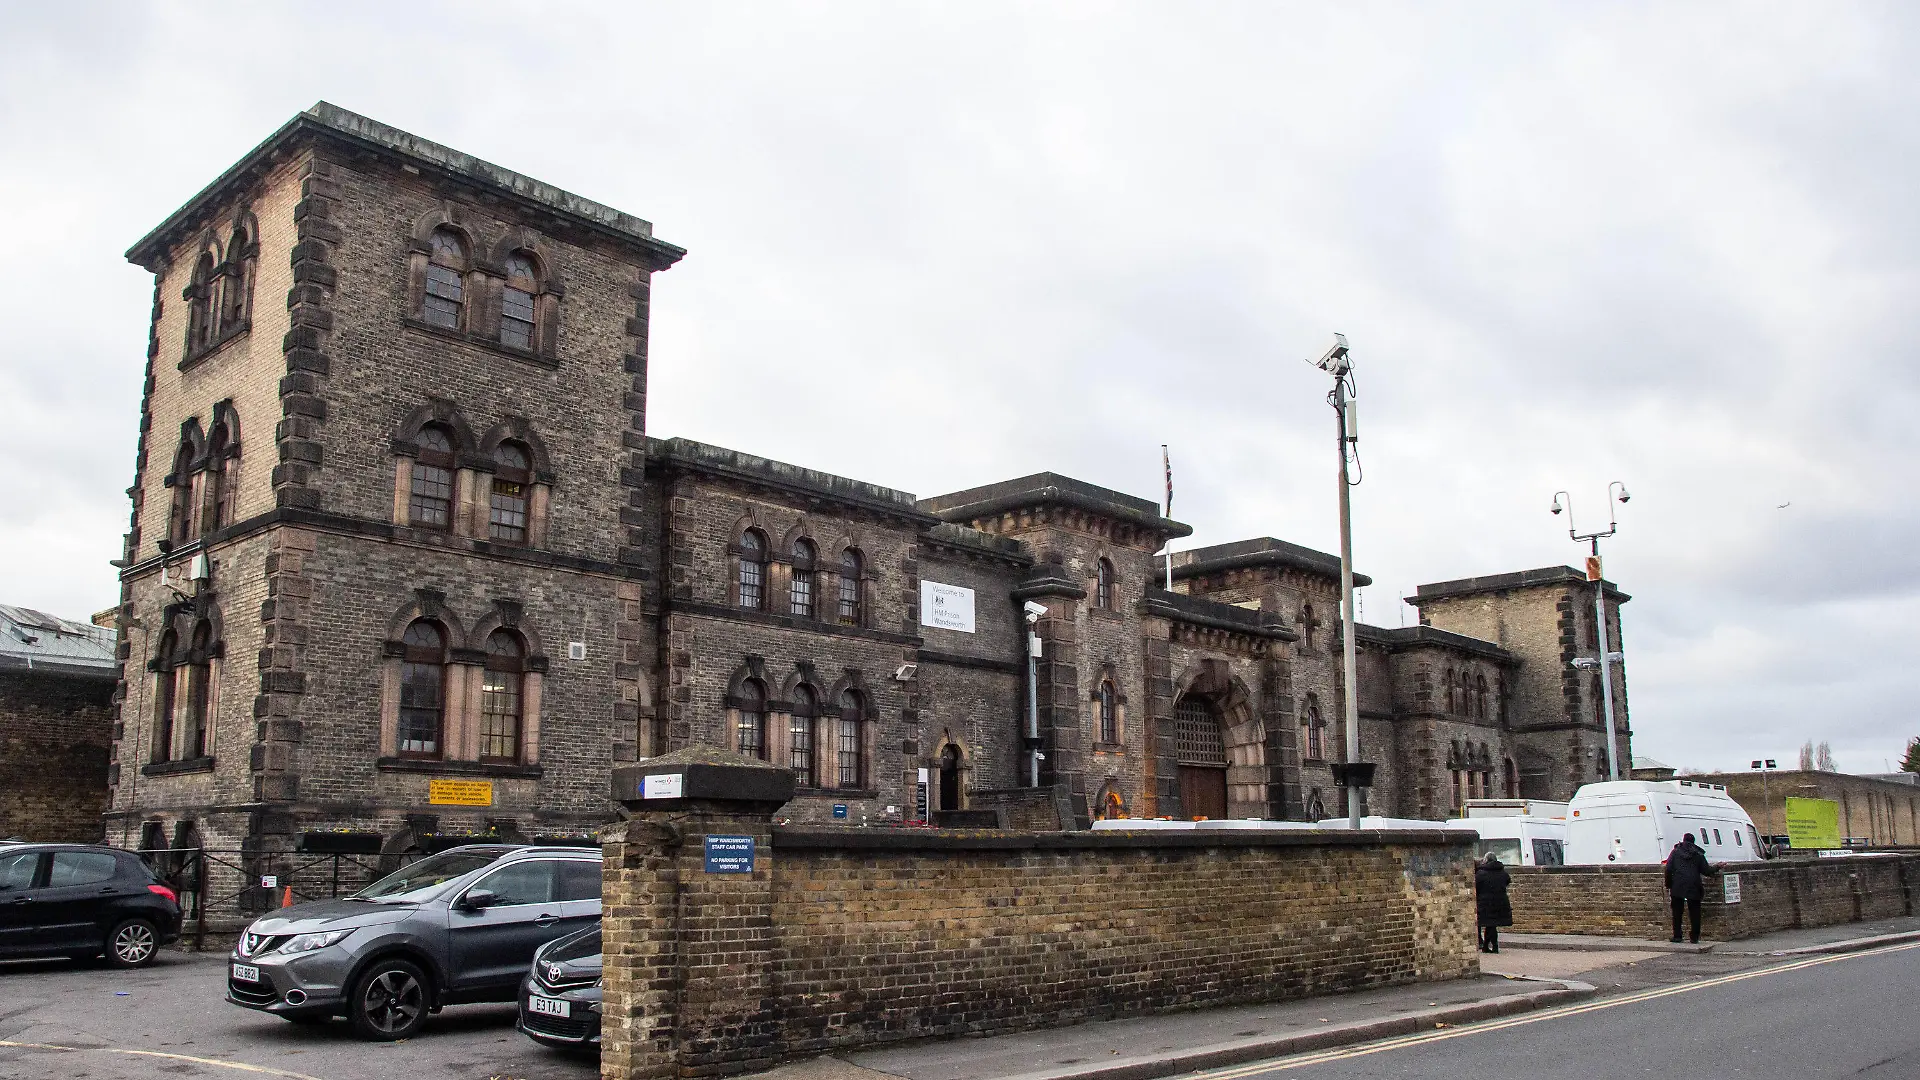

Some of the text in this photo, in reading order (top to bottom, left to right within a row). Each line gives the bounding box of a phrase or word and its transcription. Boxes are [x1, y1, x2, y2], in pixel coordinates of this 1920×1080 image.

[933, 586, 958, 596] Welcome
[945, 610, 960, 619] Prison
[934, 617, 966, 628] Wandsworth
[536, 999, 562, 1013] E3 TAJ
